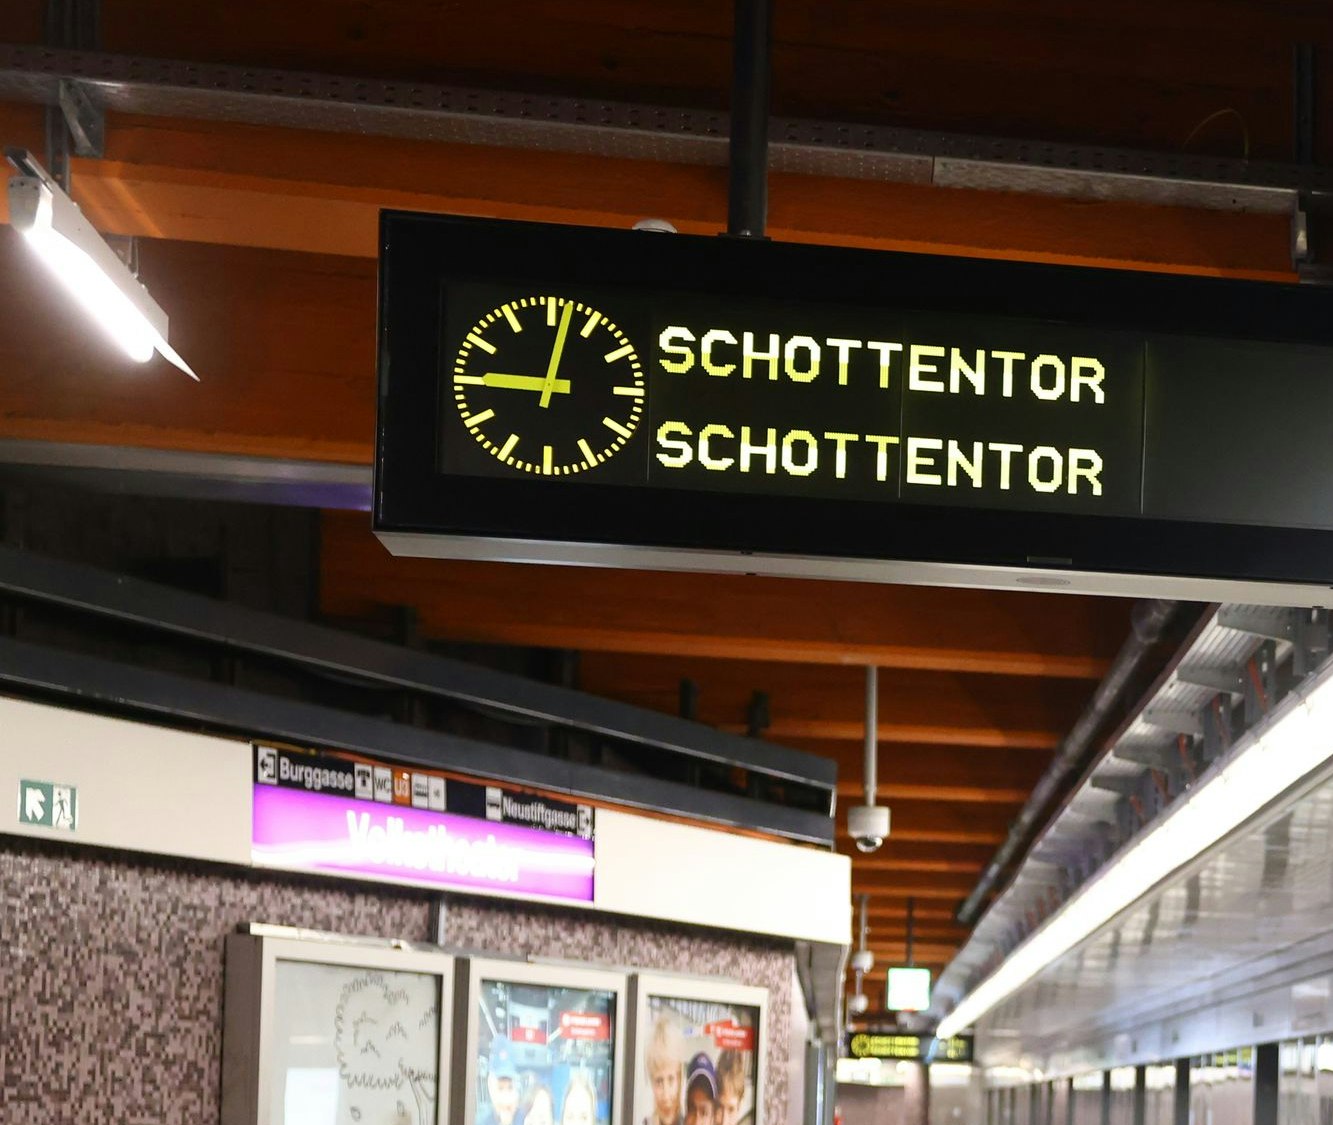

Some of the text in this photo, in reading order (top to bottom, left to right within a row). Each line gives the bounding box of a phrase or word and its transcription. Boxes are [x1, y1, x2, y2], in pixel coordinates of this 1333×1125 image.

[658, 325, 1105, 404] SCHOTTENTOR
[656, 420, 1103, 496] SCHOTTENTOR
[279, 756, 354, 791] Burggasse
[374, 776, 391, 792] WC
[502, 795, 577, 829] Neustiftgasse
